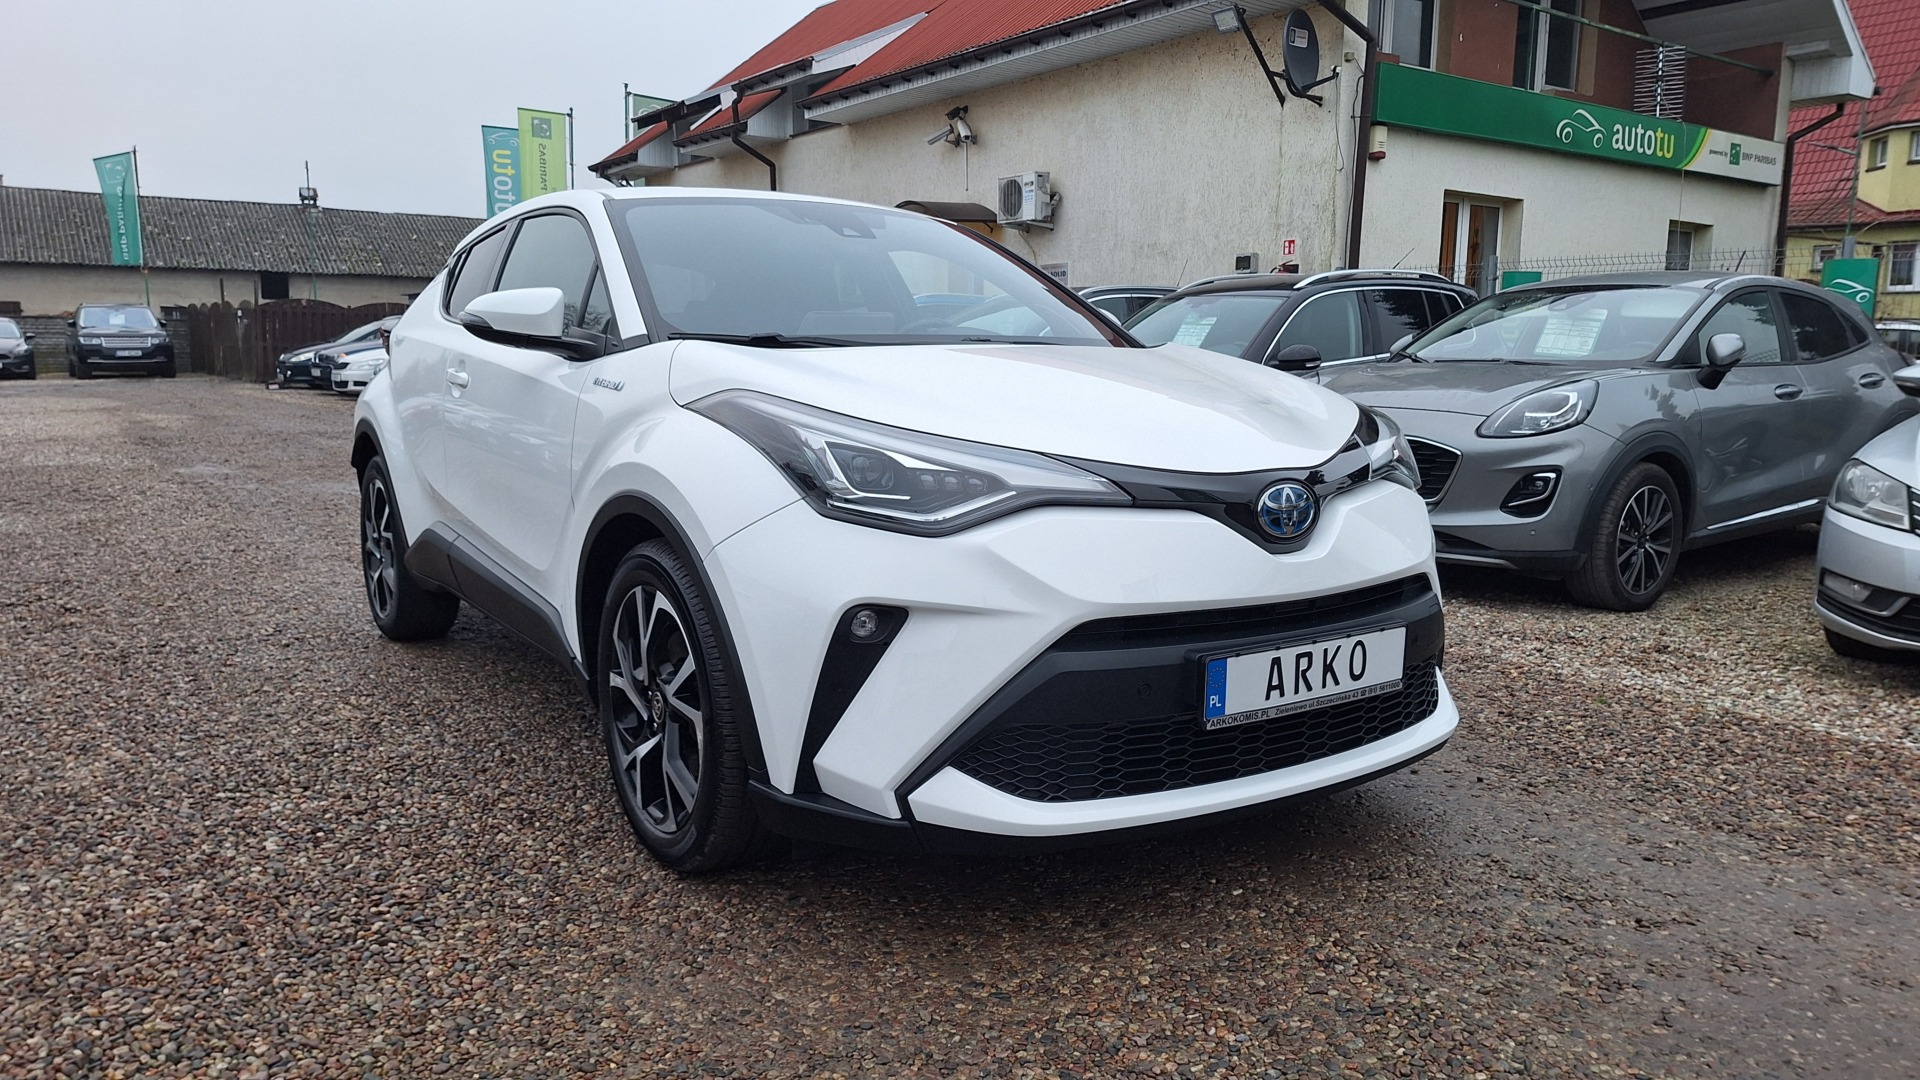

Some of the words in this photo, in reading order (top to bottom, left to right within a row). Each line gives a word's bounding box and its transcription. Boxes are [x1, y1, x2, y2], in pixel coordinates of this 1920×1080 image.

[1612, 123, 1675, 159] autotu
[1709, 149, 1723, 157] powered
[1742, 152, 1753, 161] BNP
[1754, 154, 1777, 166] PARIBAS
[1265, 639, 1367, 701] ARKO
[1209, 694, 1222, 708] PL
[1209, 711, 1271, 728] ARKOKOMIS.PL
[1274, 704, 1307, 716] Zieleniewo
[1367, 686, 1378, 695] (91)
